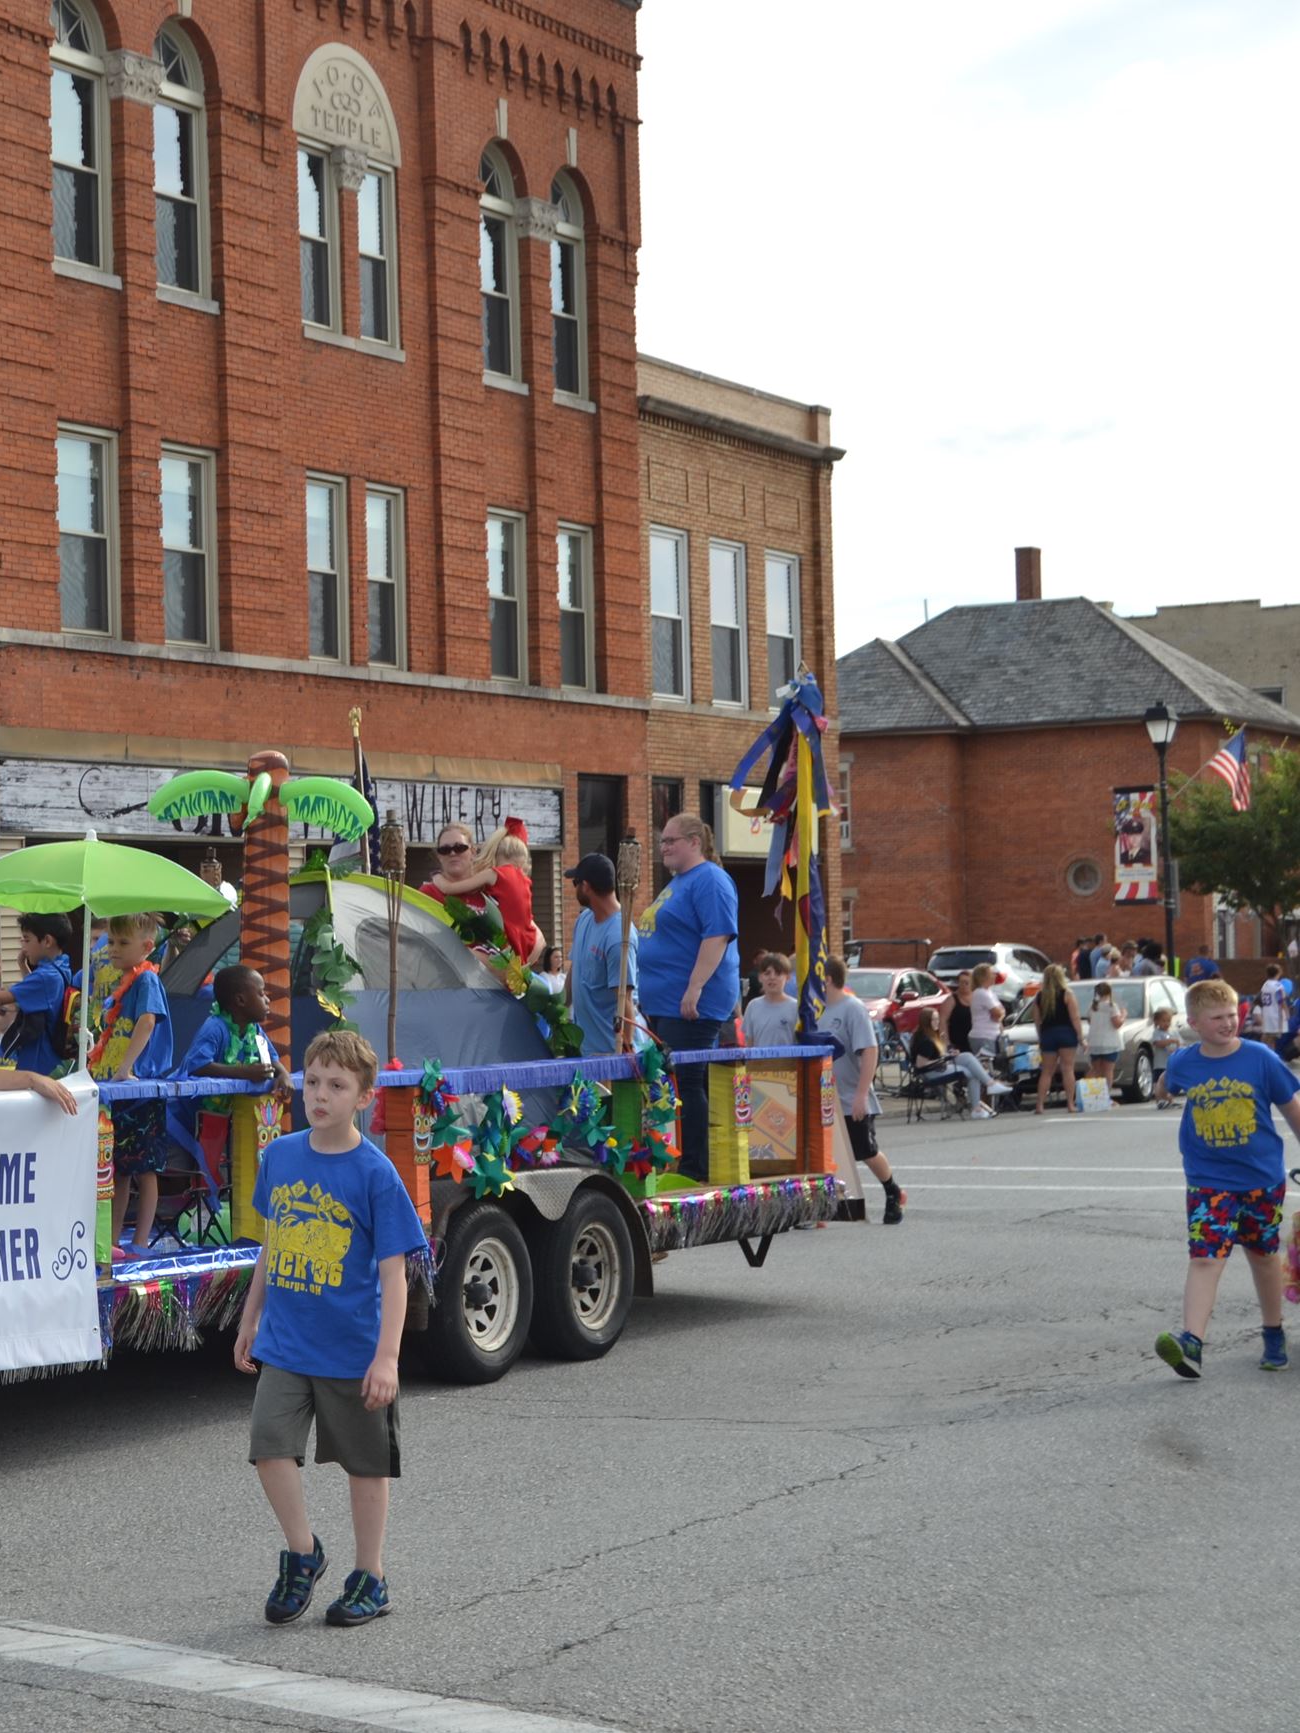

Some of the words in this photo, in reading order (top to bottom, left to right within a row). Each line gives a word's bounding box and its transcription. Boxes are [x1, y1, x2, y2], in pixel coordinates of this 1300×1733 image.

[311, 104, 381, 149] TEMPLE
[405, 783, 503, 843] WINERY
[267, 1249, 309, 1281] ACK
